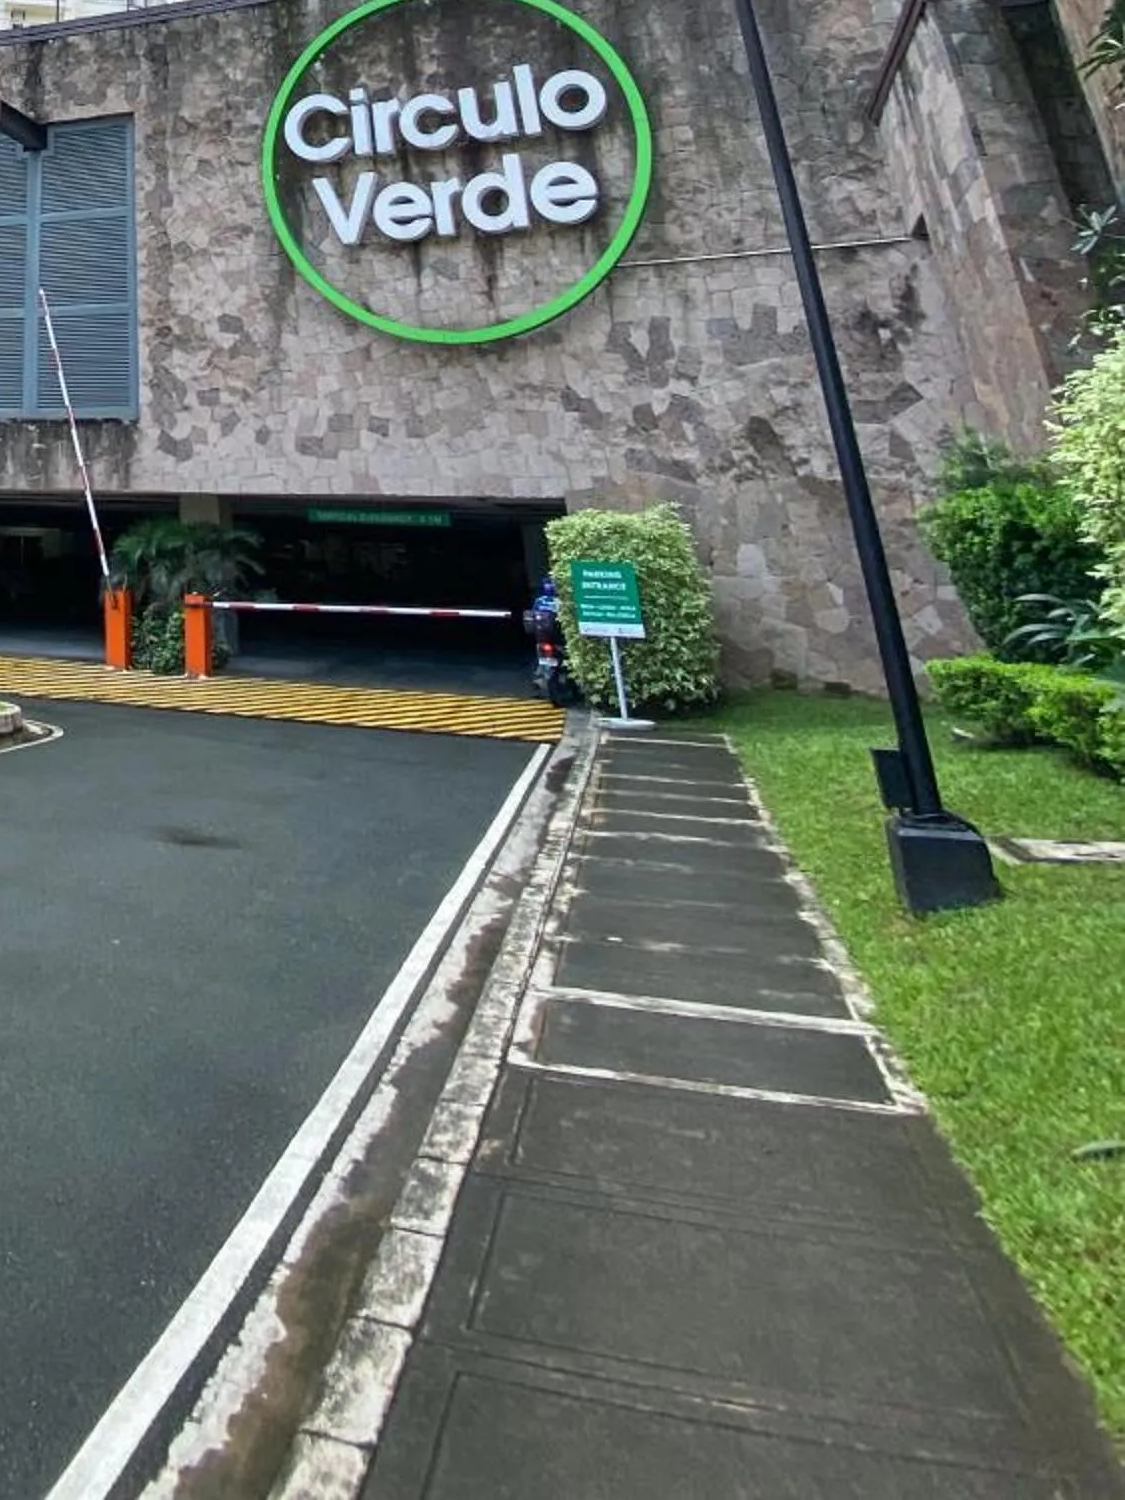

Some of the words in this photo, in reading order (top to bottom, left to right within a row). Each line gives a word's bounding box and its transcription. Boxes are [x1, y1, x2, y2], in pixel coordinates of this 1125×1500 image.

[284, 64, 608, 163] Circulo
[312, 154, 599, 245] Verde
[581, 581, 626, 591] ENTRANCE
[582, 569, 622, 579] PARKING
